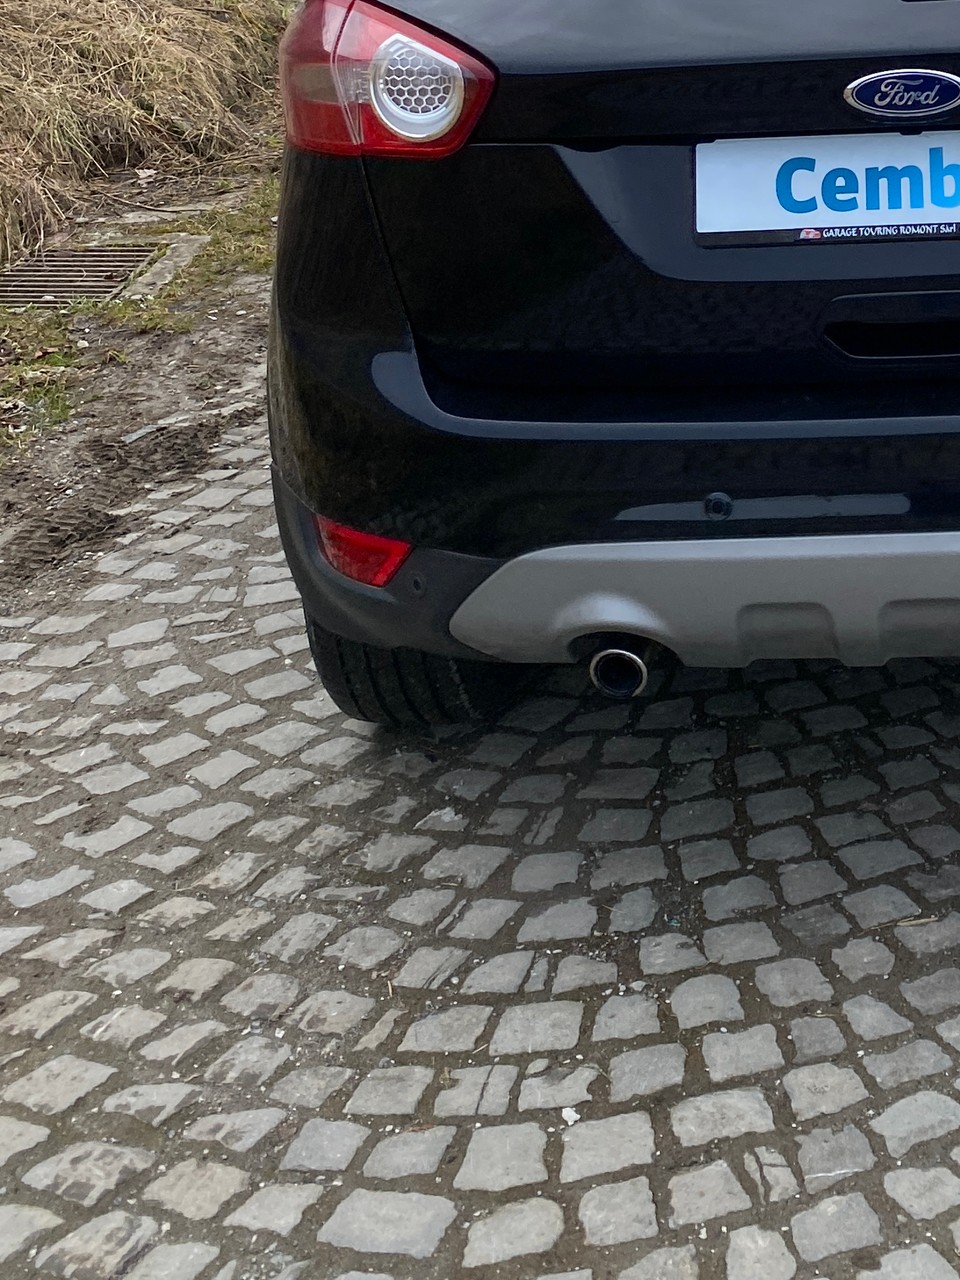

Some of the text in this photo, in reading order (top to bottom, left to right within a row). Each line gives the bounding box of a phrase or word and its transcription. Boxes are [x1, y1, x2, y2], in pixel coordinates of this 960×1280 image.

[874, 78, 940, 107] Ford
[823, 227, 857, 238] GARAGE
[859, 226, 898, 236] TOURING
[900, 225, 938, 235] ROMONT
